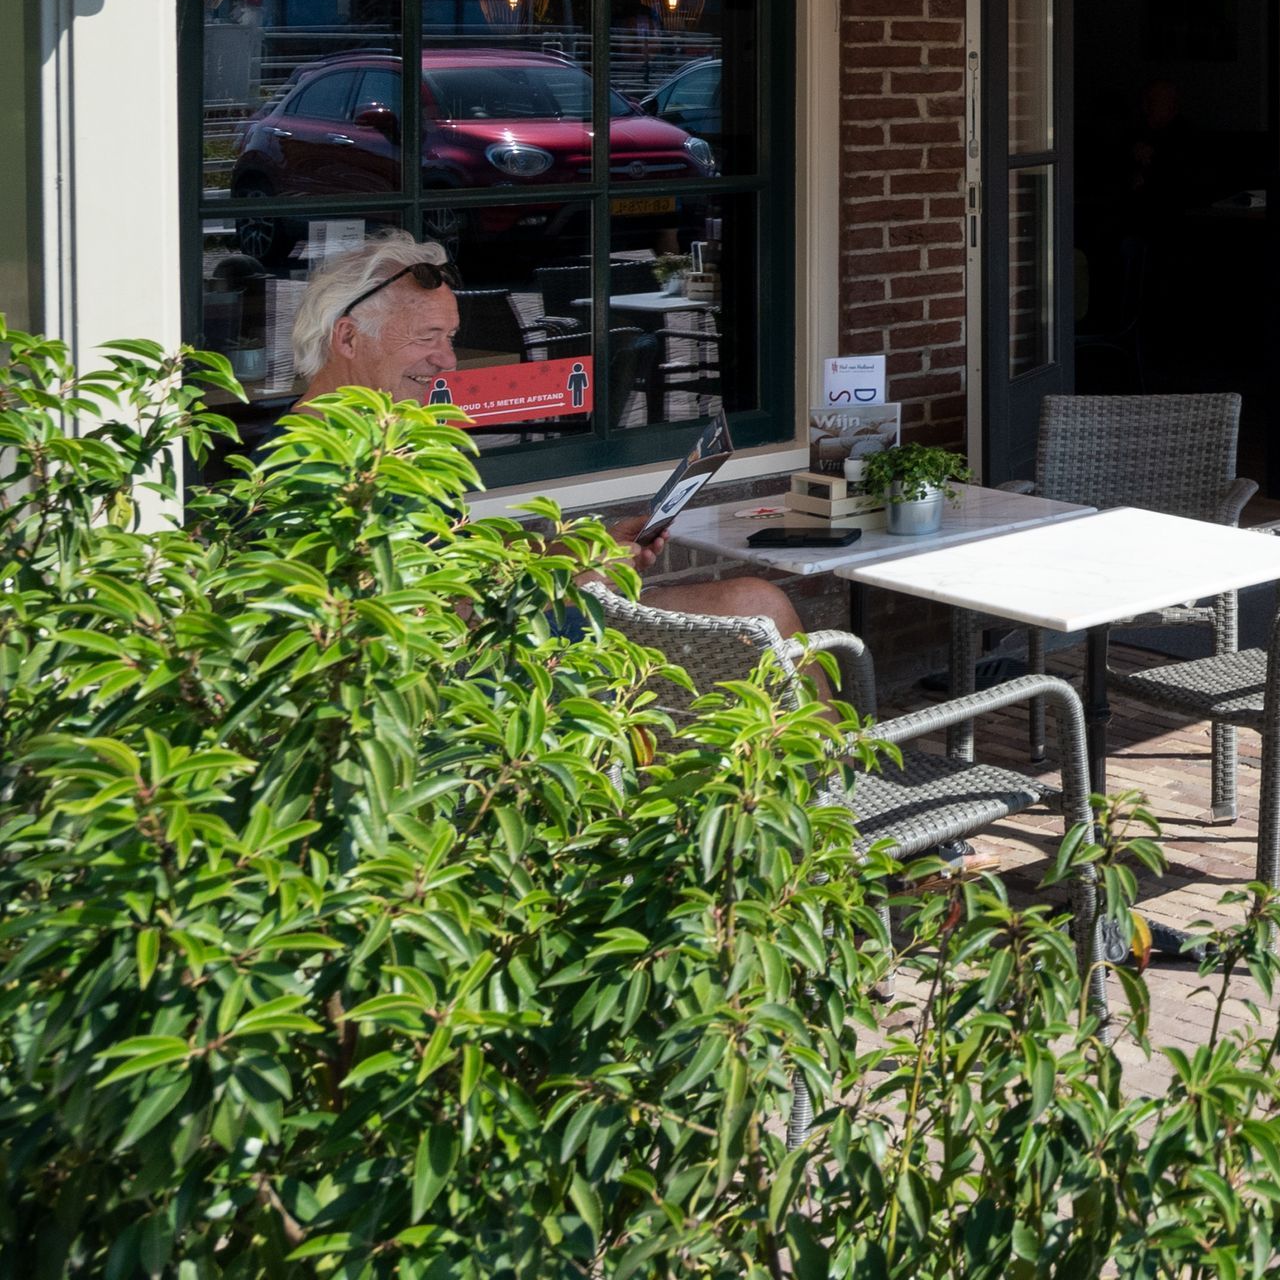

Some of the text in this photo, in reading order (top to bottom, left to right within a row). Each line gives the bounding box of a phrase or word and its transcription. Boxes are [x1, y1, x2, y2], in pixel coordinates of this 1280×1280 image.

[483, 401, 495, 410] 1,5
[496, 397, 525, 407] METER
[527, 392, 564, 403] AFSTAND
[814, 414, 860, 431] Wijn
